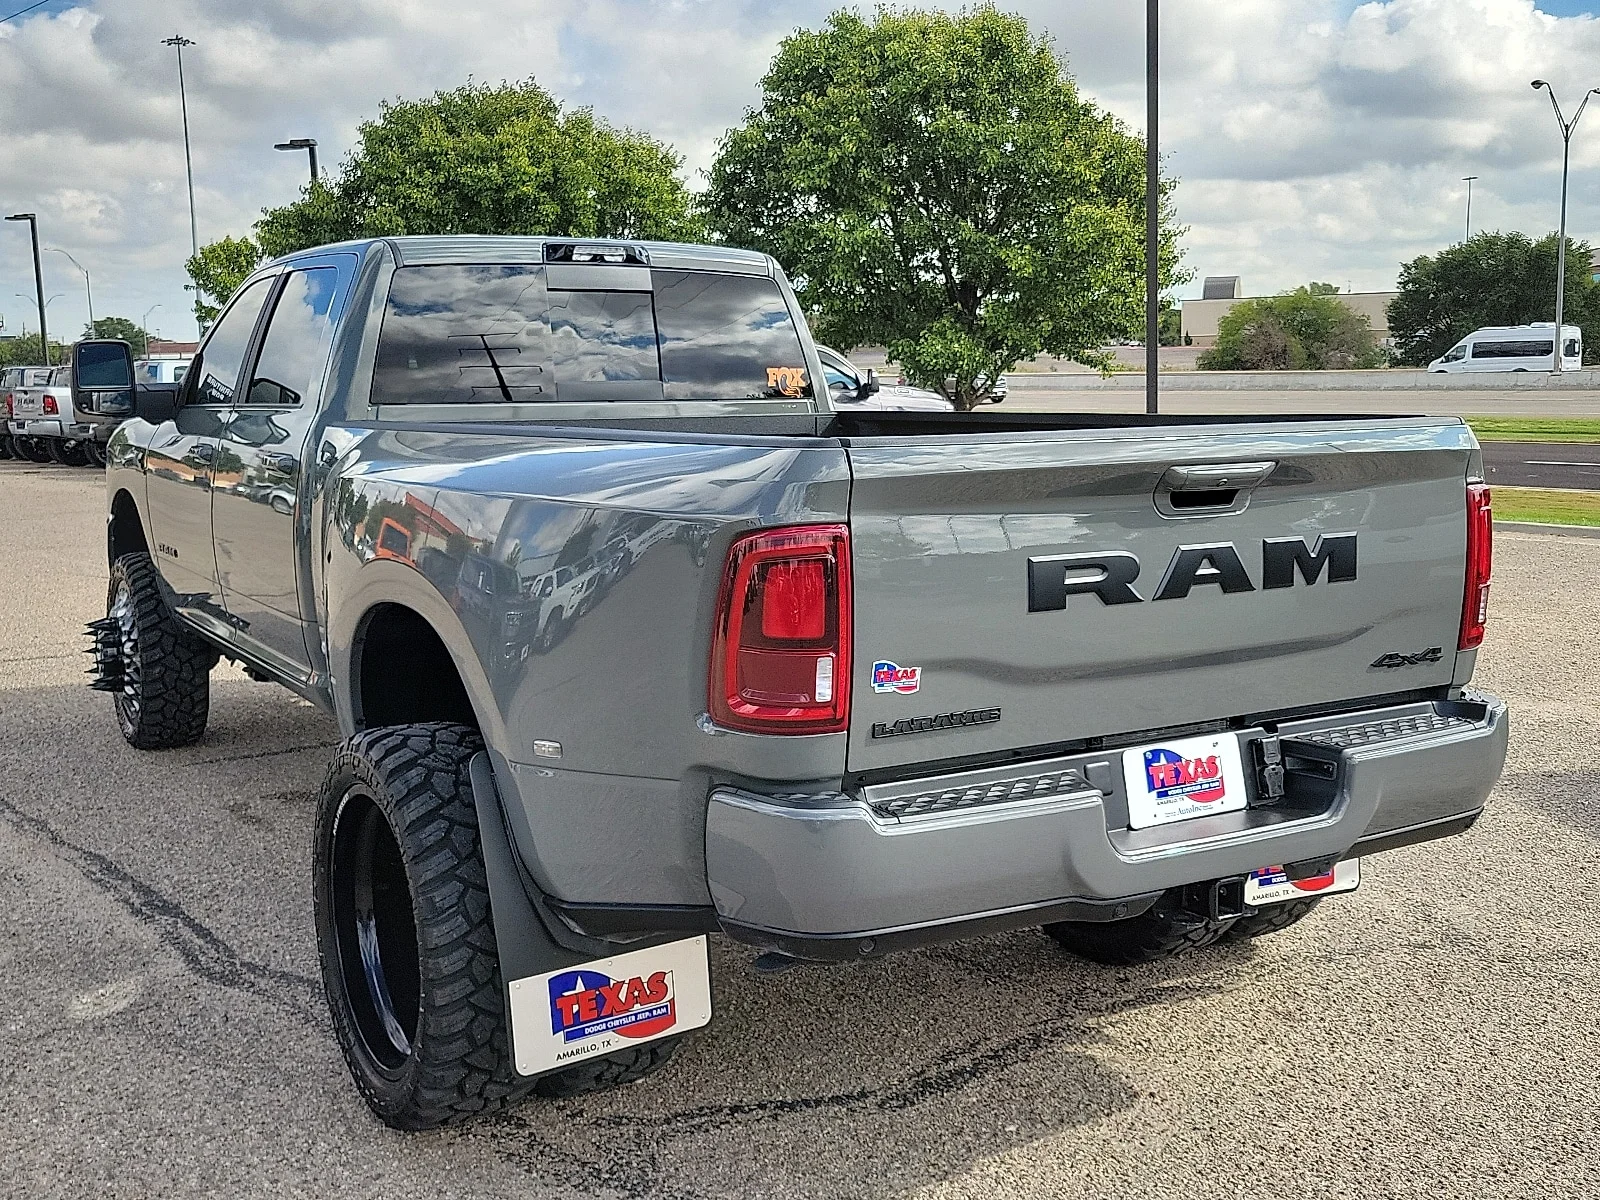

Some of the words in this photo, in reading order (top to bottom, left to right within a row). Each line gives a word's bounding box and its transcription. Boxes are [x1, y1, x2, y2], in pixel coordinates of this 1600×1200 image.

[766, 367, 806, 398] FOX
[1027, 531, 1358, 613] RAM
[876, 669, 917, 682] TEXAS
[872, 706, 1001, 738] LARAMIE
[1149, 755, 1219, 789] TEXAS
[556, 971, 668, 1026] TEXAS
[585, 1023, 606, 1034] DODGE
[607, 1016, 636, 1029] CHRYSLER
[652, 1007, 667, 1016] RAM
[556, 1043, 599, 1061] AMARILLO,
[601, 1039, 612, 1048] TX
